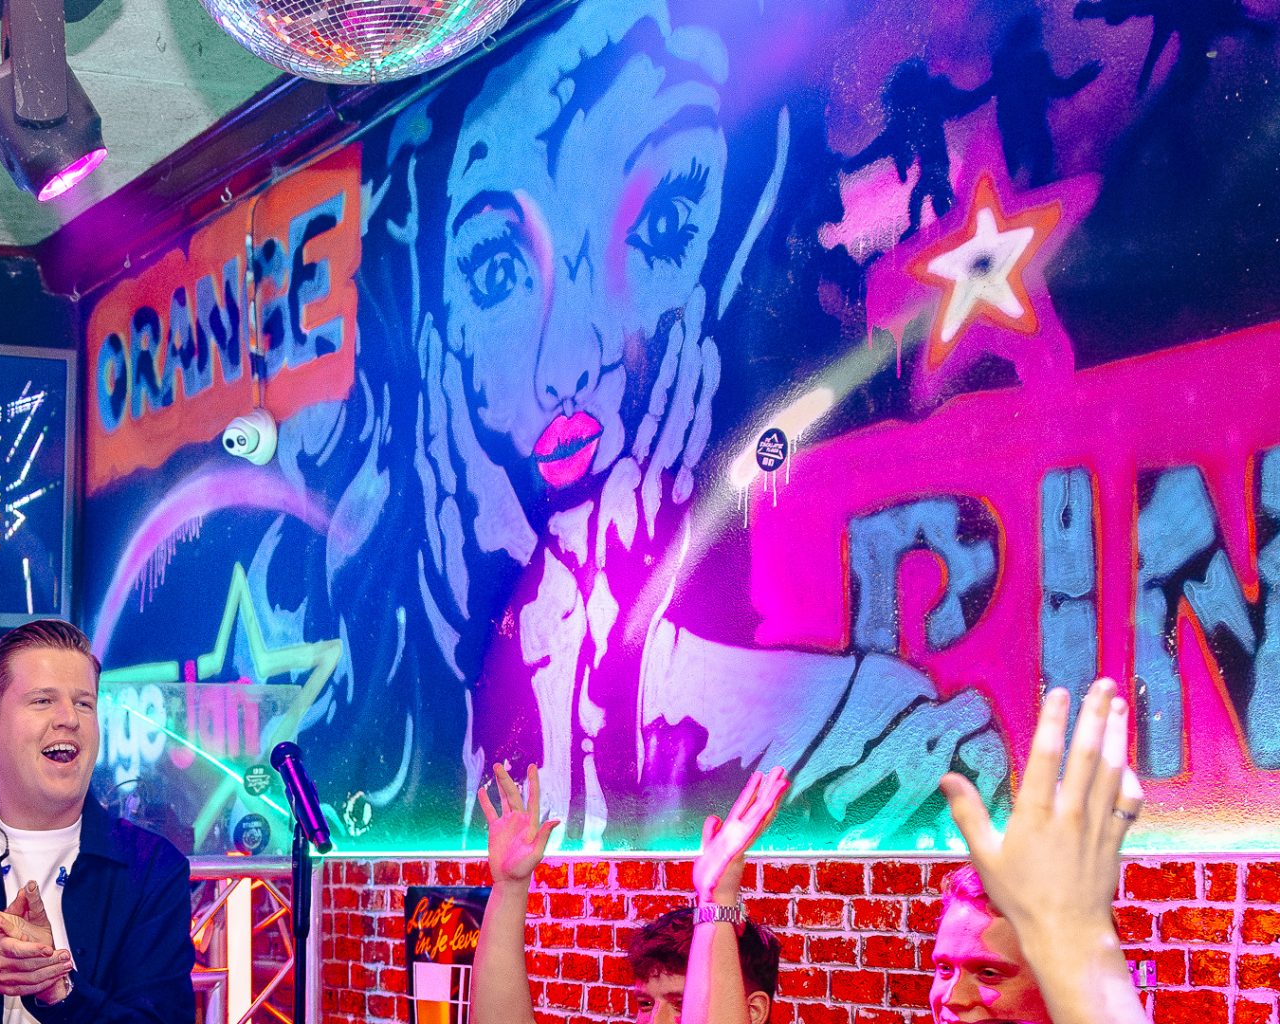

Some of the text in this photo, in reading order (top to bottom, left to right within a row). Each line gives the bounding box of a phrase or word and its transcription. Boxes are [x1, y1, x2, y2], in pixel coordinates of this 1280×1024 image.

[96, 190, 346, 433] ORANGE
[406, 896, 455, 934] Lust
[449, 922, 481, 951] leve
